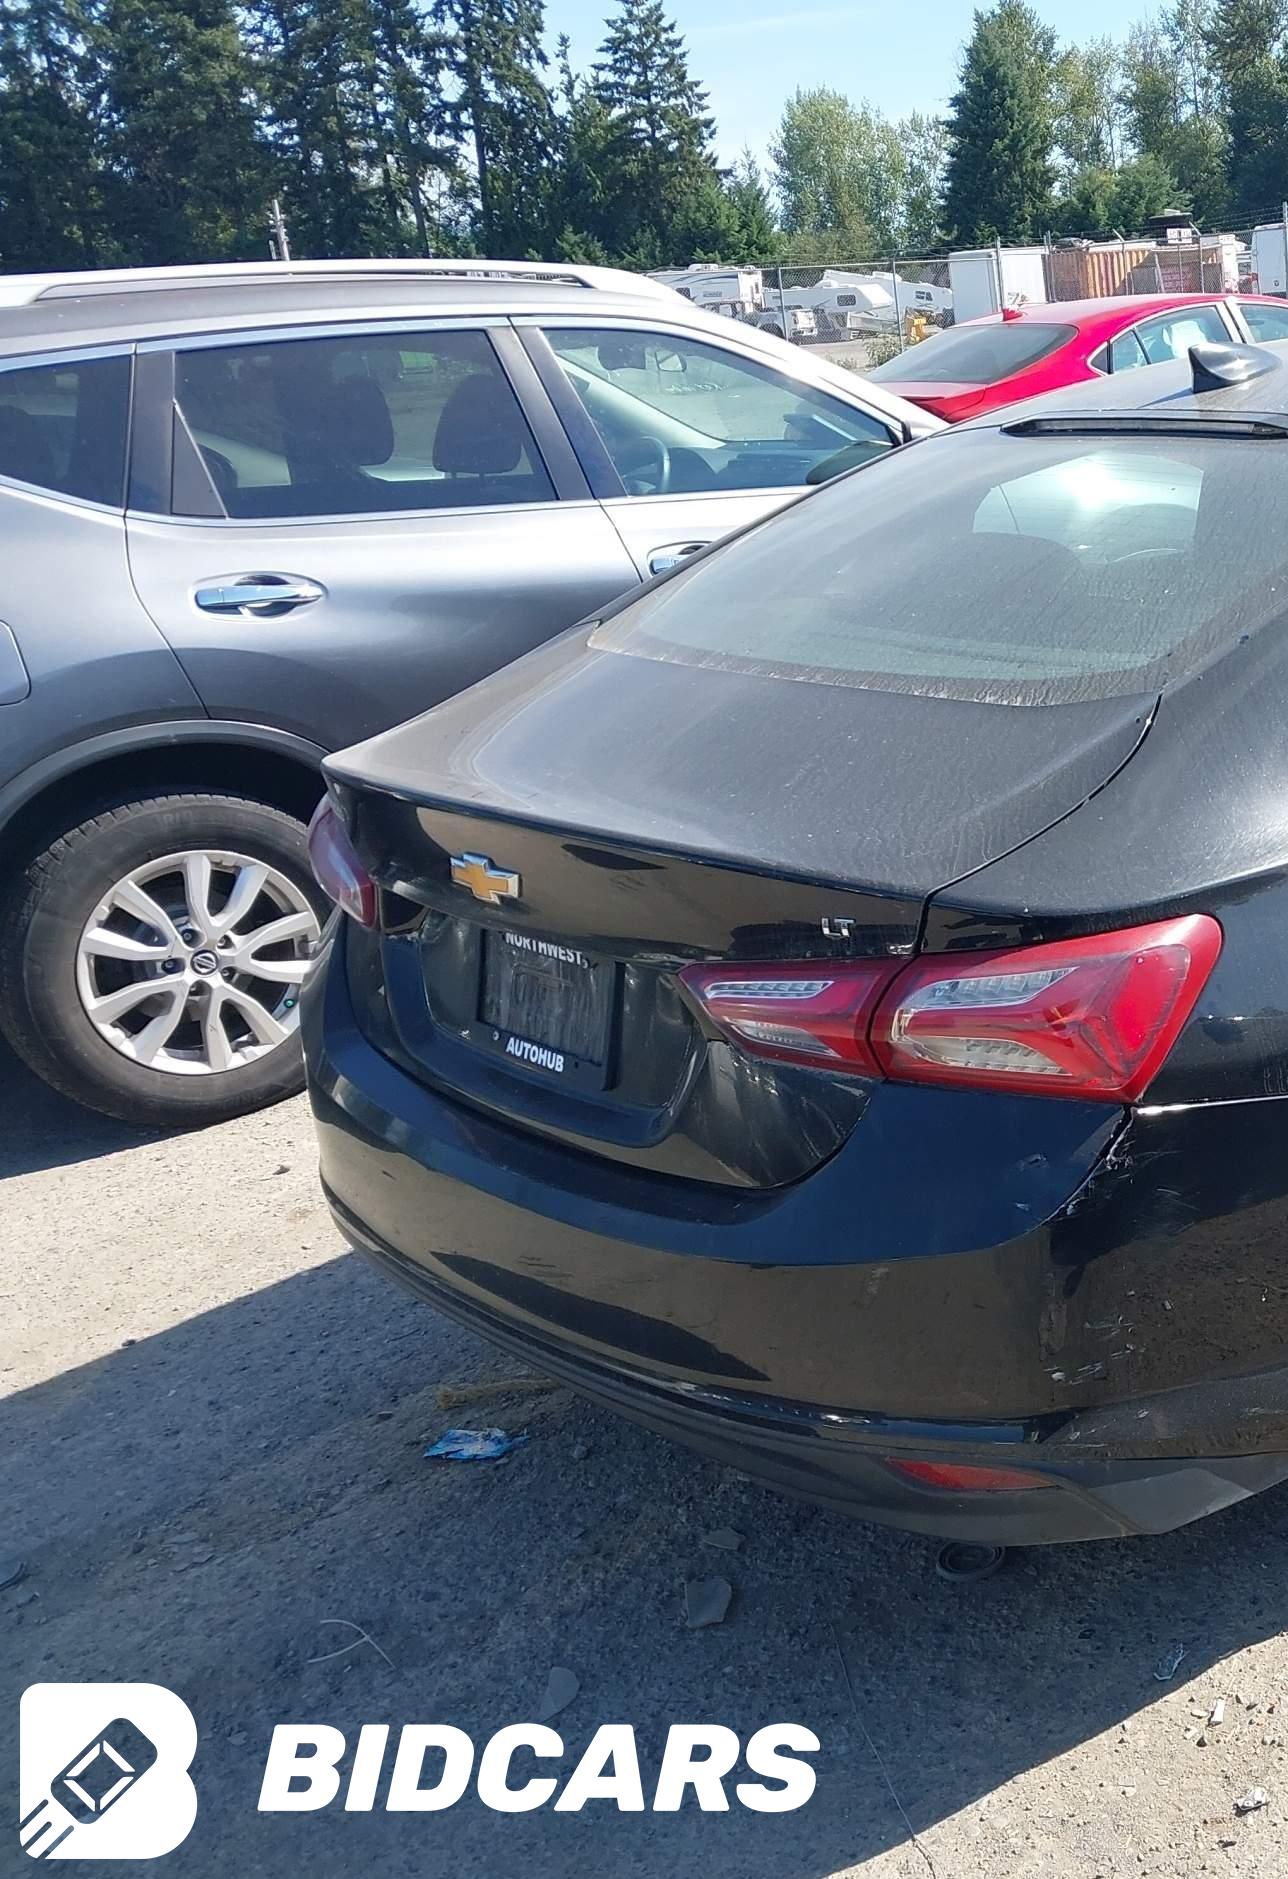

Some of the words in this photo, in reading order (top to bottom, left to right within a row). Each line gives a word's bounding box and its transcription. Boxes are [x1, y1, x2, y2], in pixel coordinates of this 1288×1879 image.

[821, 917, 855, 938] LT
[505, 932, 582, 966] NORTHWEST
[505, 1037, 565, 1073] AUTOHUB
